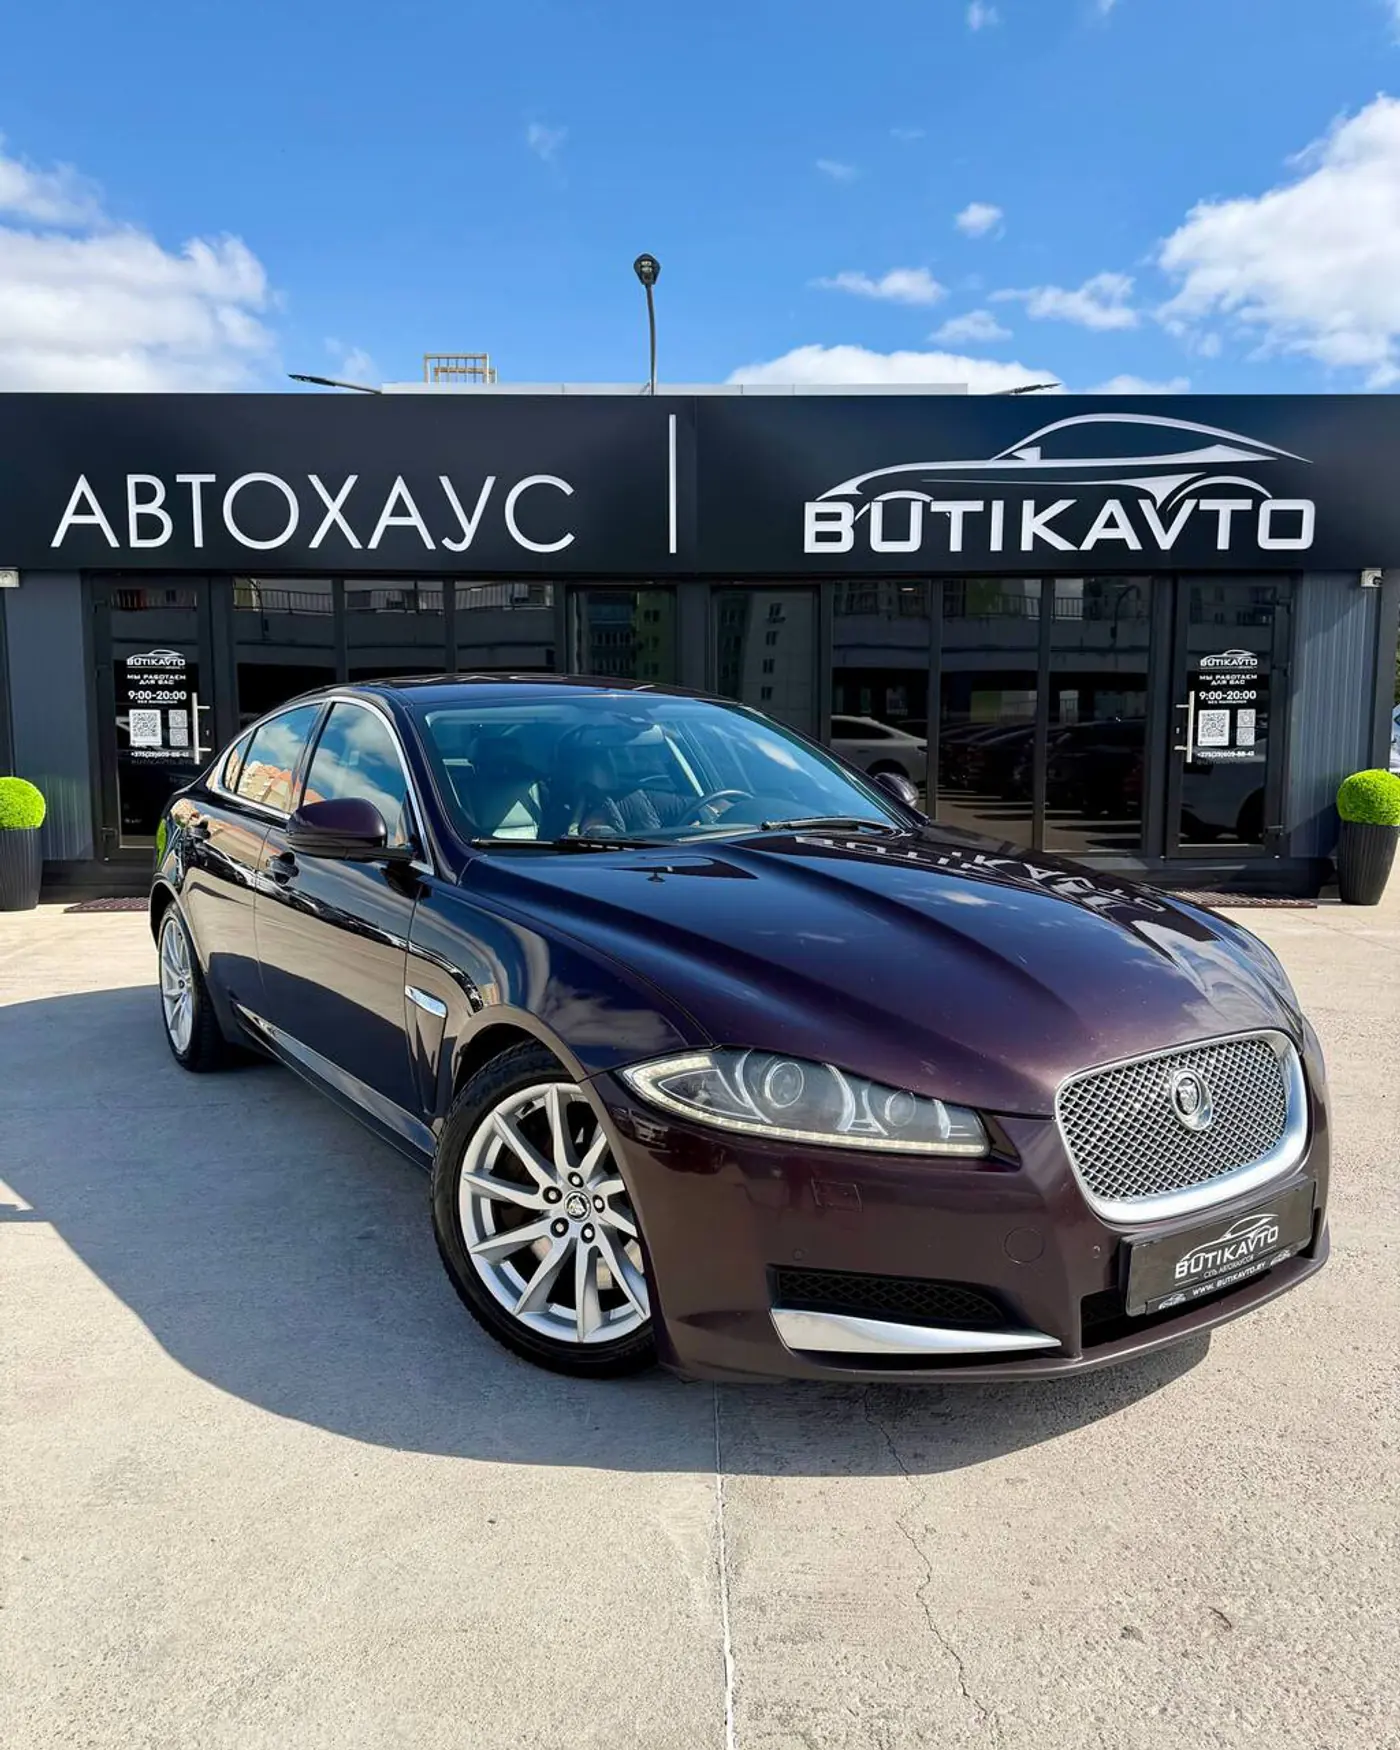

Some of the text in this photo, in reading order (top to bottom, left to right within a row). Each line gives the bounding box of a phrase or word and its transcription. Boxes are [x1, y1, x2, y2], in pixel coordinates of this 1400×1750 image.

[50, 472, 575, 553] АВТОХАУС
[804, 498, 1315, 553] BUTIKAVTO
[126, 657, 186, 666] BUTIKAVTO
[1200, 657, 1258, 666] BUTIKAVTO
[128, 690, 187, 700] 9:00-20:00
[1199, 690, 1257, 700] 9:00-20:00
[1175, 1225, 1279, 1279] BUTIKAVTO
